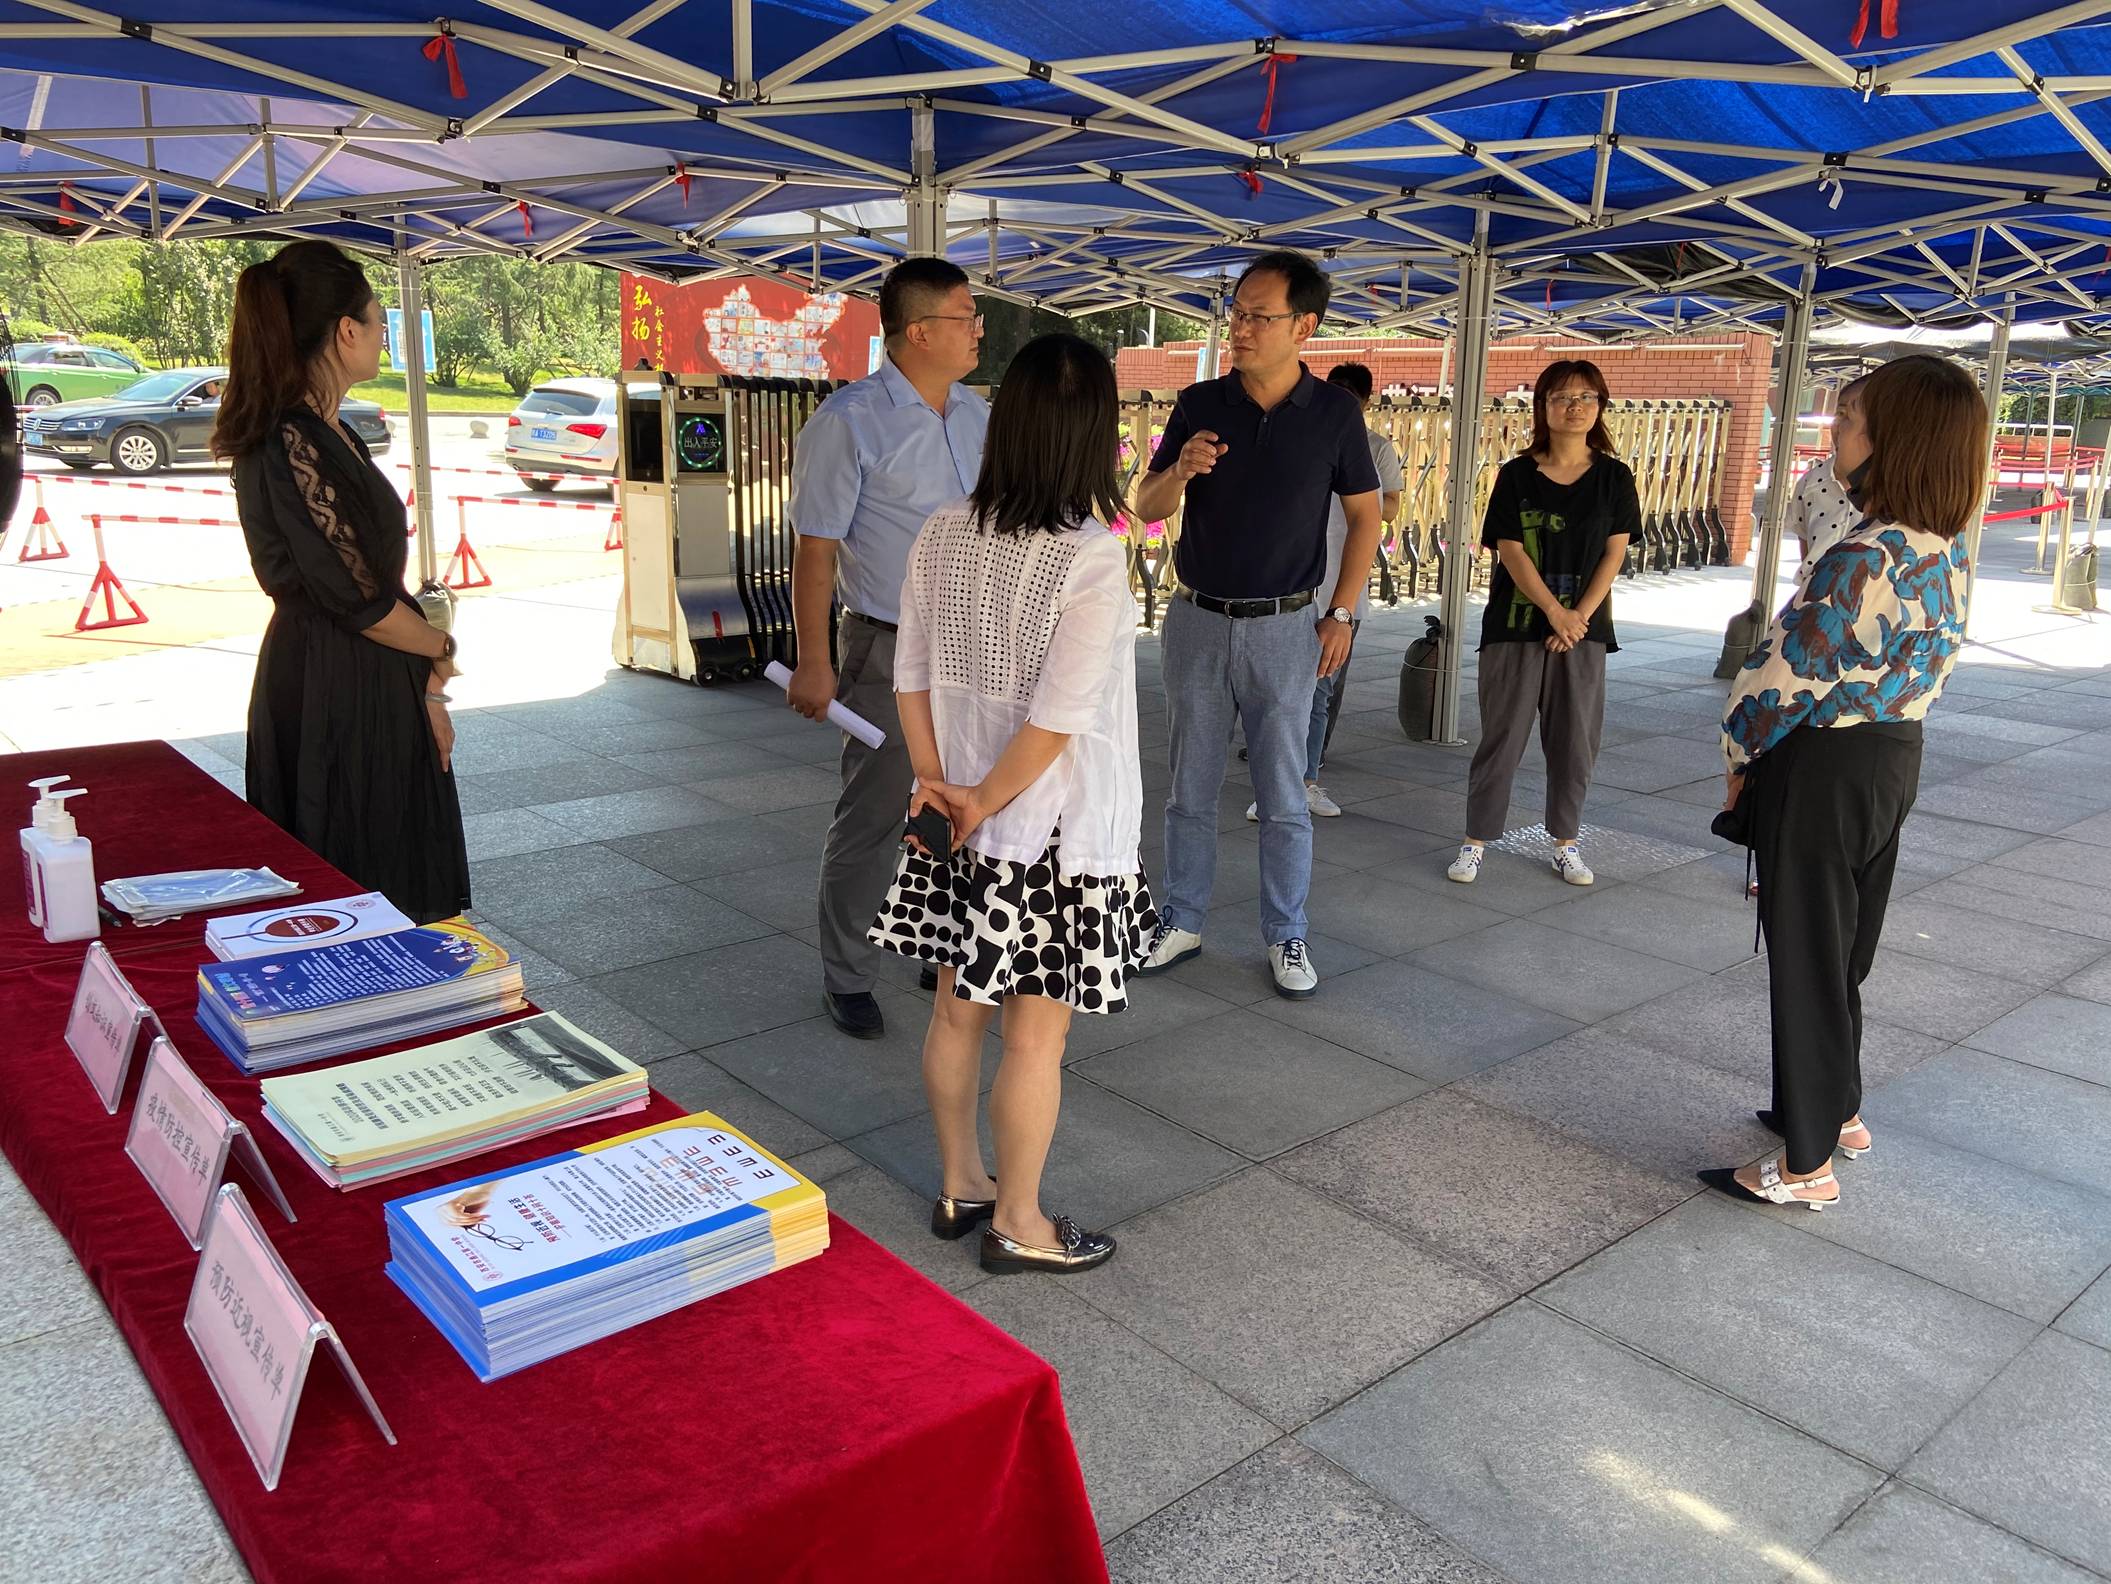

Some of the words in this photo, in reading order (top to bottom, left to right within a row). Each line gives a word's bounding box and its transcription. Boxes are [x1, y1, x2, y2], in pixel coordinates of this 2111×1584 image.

[632, 285, 652, 340] 弘扬
[684, 436, 717, 448] 出入平安
[145, 1092, 210, 1186] 疫情防控宣传单
[210, 1260, 285, 1400] 预防近视宣传单
